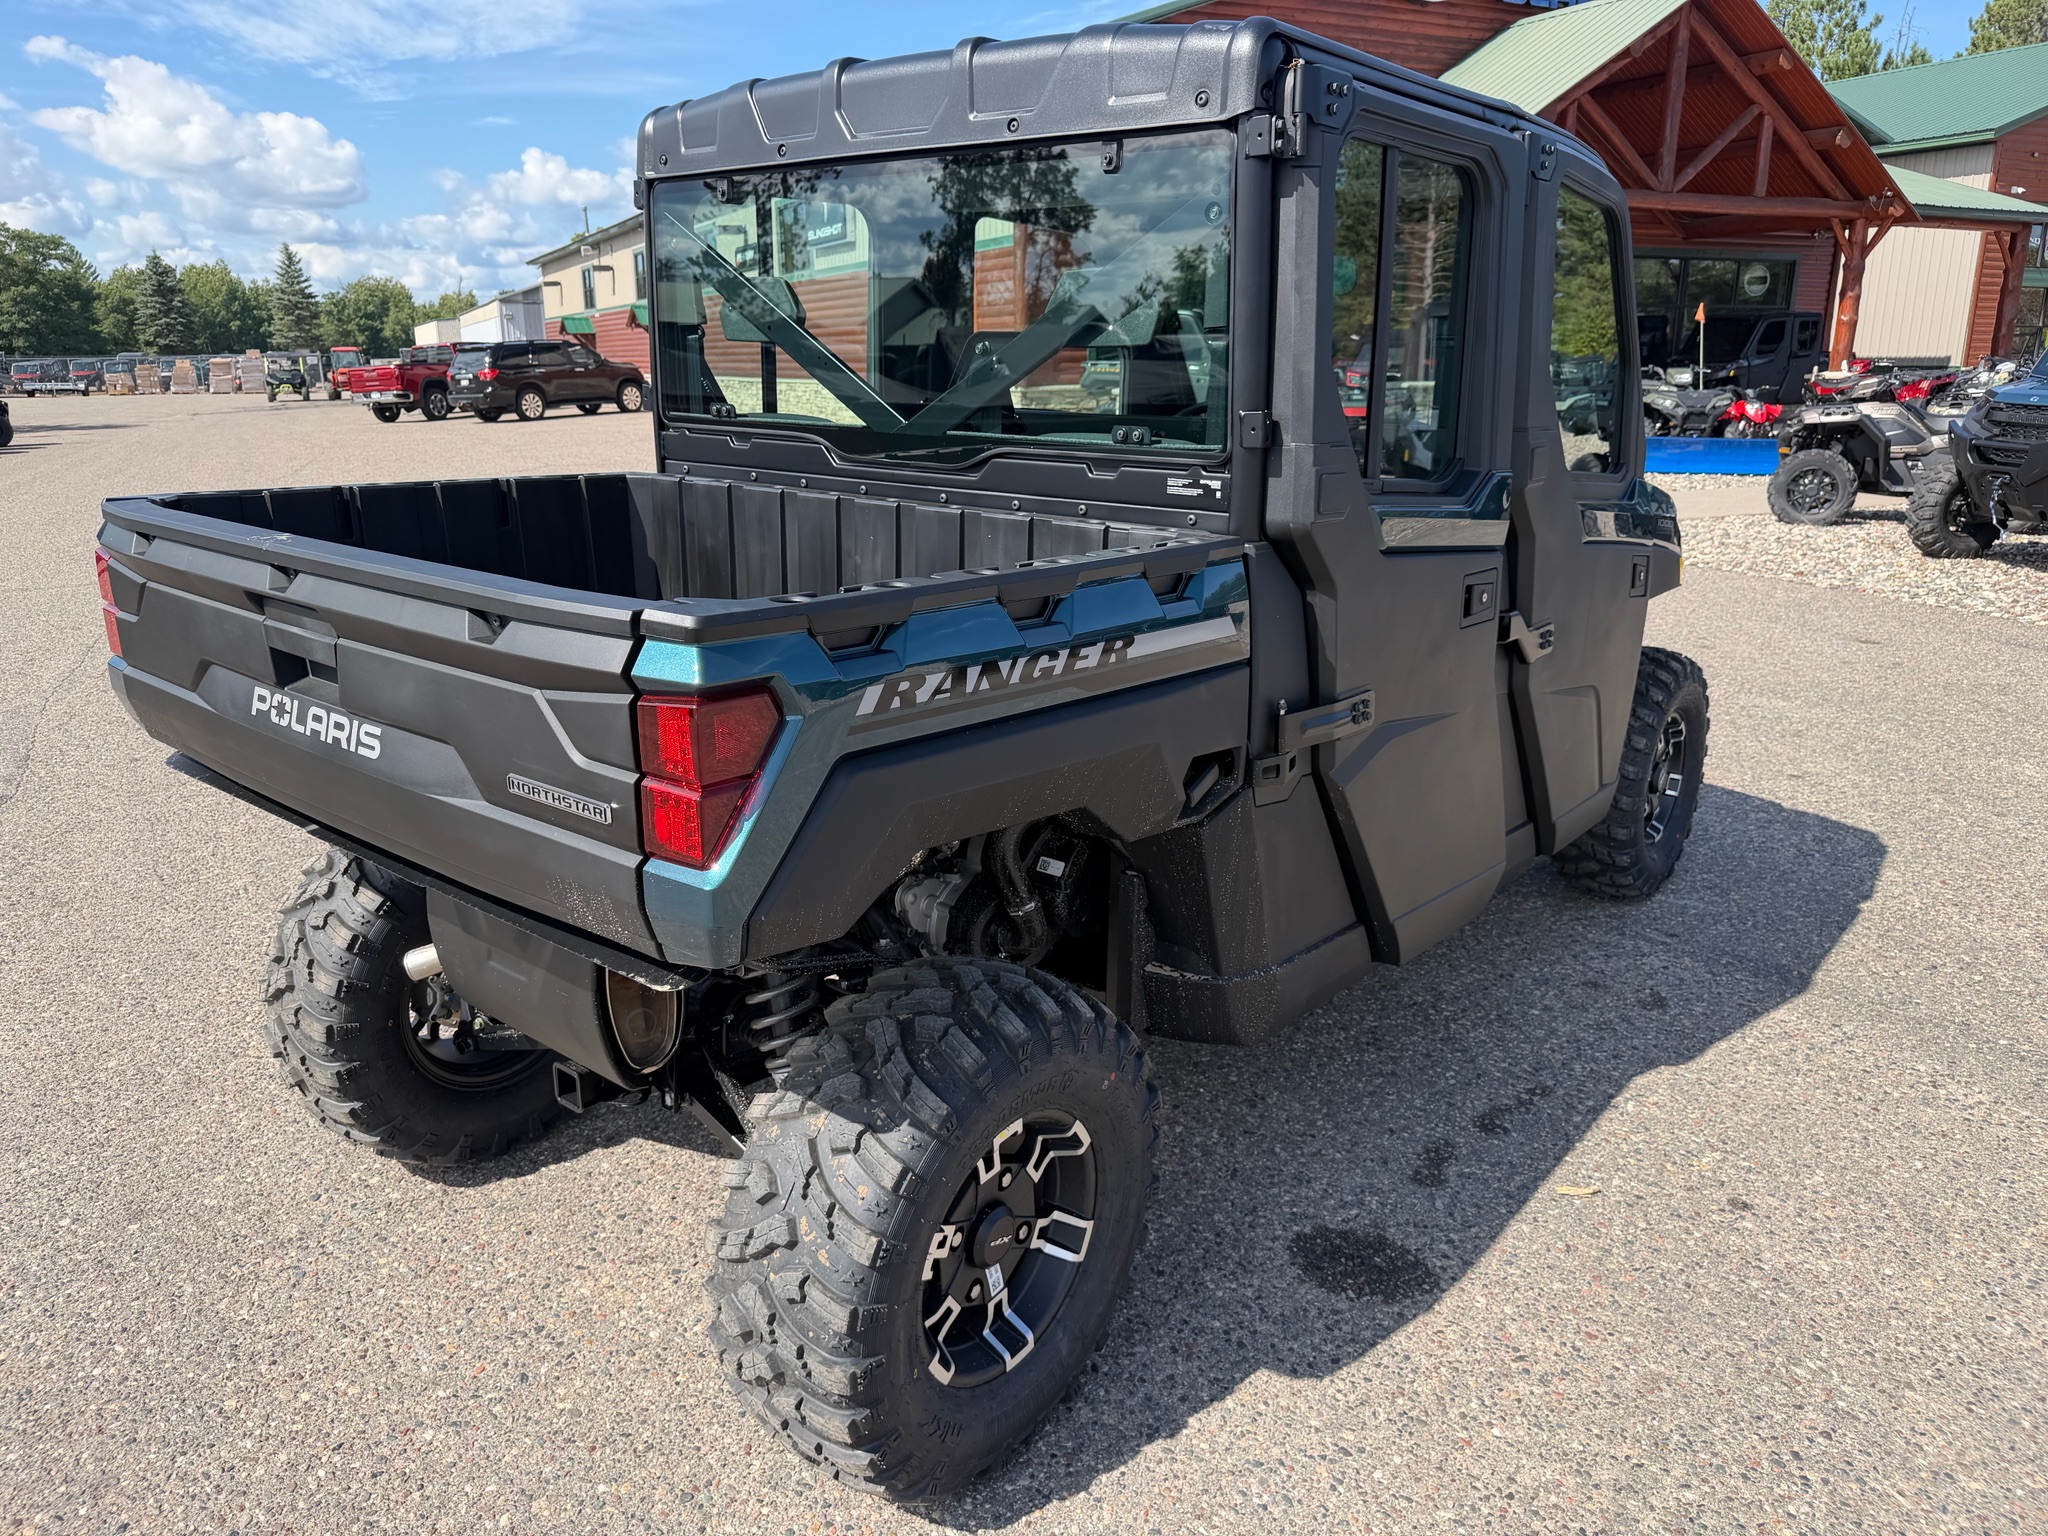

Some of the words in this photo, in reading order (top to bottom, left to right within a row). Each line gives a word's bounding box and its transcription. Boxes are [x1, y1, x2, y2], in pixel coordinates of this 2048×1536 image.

[871, 635, 1135, 716] RANGER
[251, 686, 382, 760] POLARIS
[511, 779, 604, 820] NORTHSTAR
